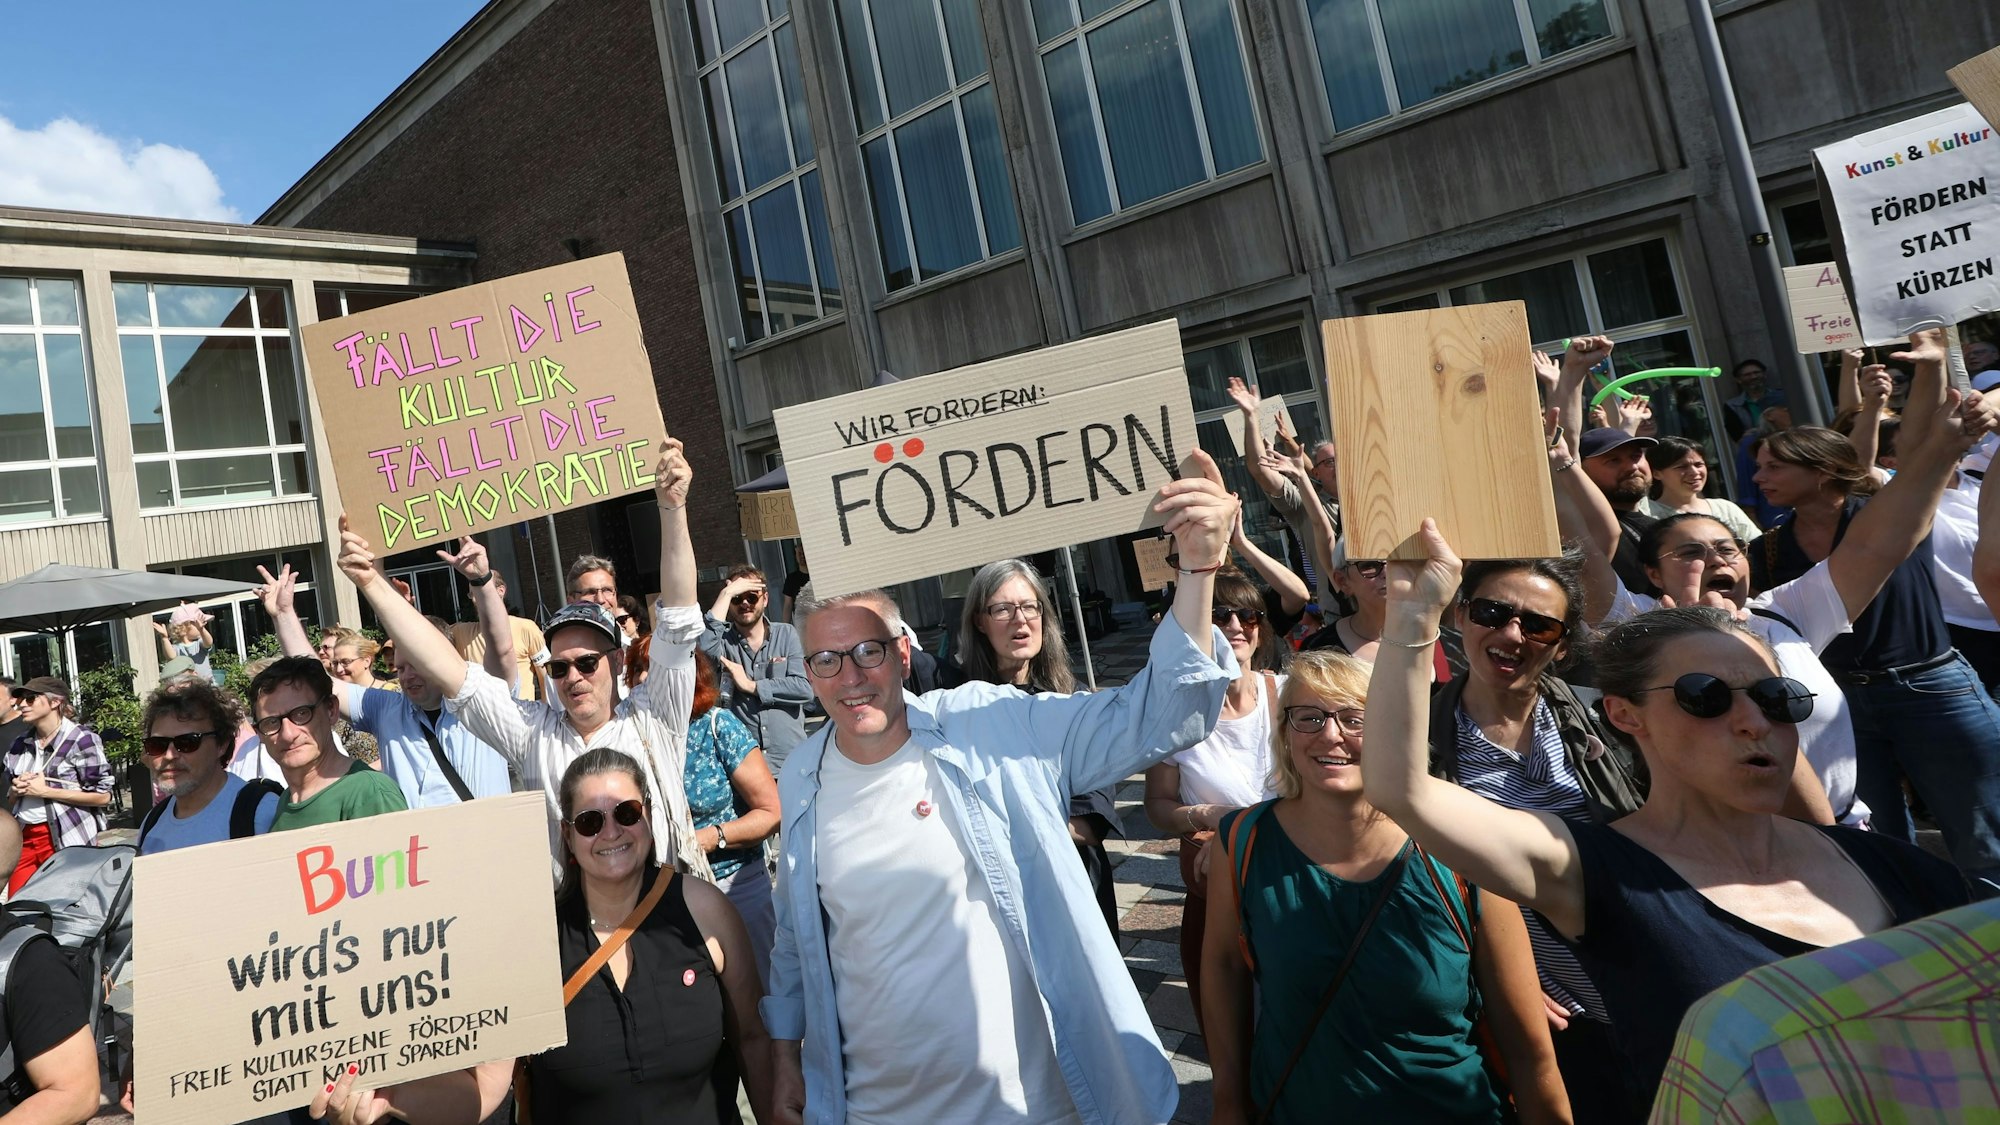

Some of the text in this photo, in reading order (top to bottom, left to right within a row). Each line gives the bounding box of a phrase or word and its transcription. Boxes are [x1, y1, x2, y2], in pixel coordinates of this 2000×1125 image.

[1845, 128, 1990, 179] Kunst & Kultur
[1871, 176, 1987, 226] FÖRDERN
[1901, 222, 1972, 258] STATT
[1896, 257, 1993, 300] KÜRZEN
[334, 316, 483, 388] FÄLLT
[1804, 315, 1851, 332] Freie
[1825, 332, 1853, 344] gegen
[399, 356, 577, 429] KULTUR
[834, 384, 1047, 446] WIR FORDERN:
[368, 415, 523, 493] FÄLLT
[831, 405, 1182, 547] FÖRDERN
[296, 834, 429, 916] Bunt
[227, 916, 458, 992] wird's nur
[251, 953, 450, 1047] mit uns!
[170, 1006, 509, 1098] FREIE KULTURSZENE FÖRDERN
[252, 1069, 311, 1102] STATT
[397, 1030, 478, 1067] SPAREN!
